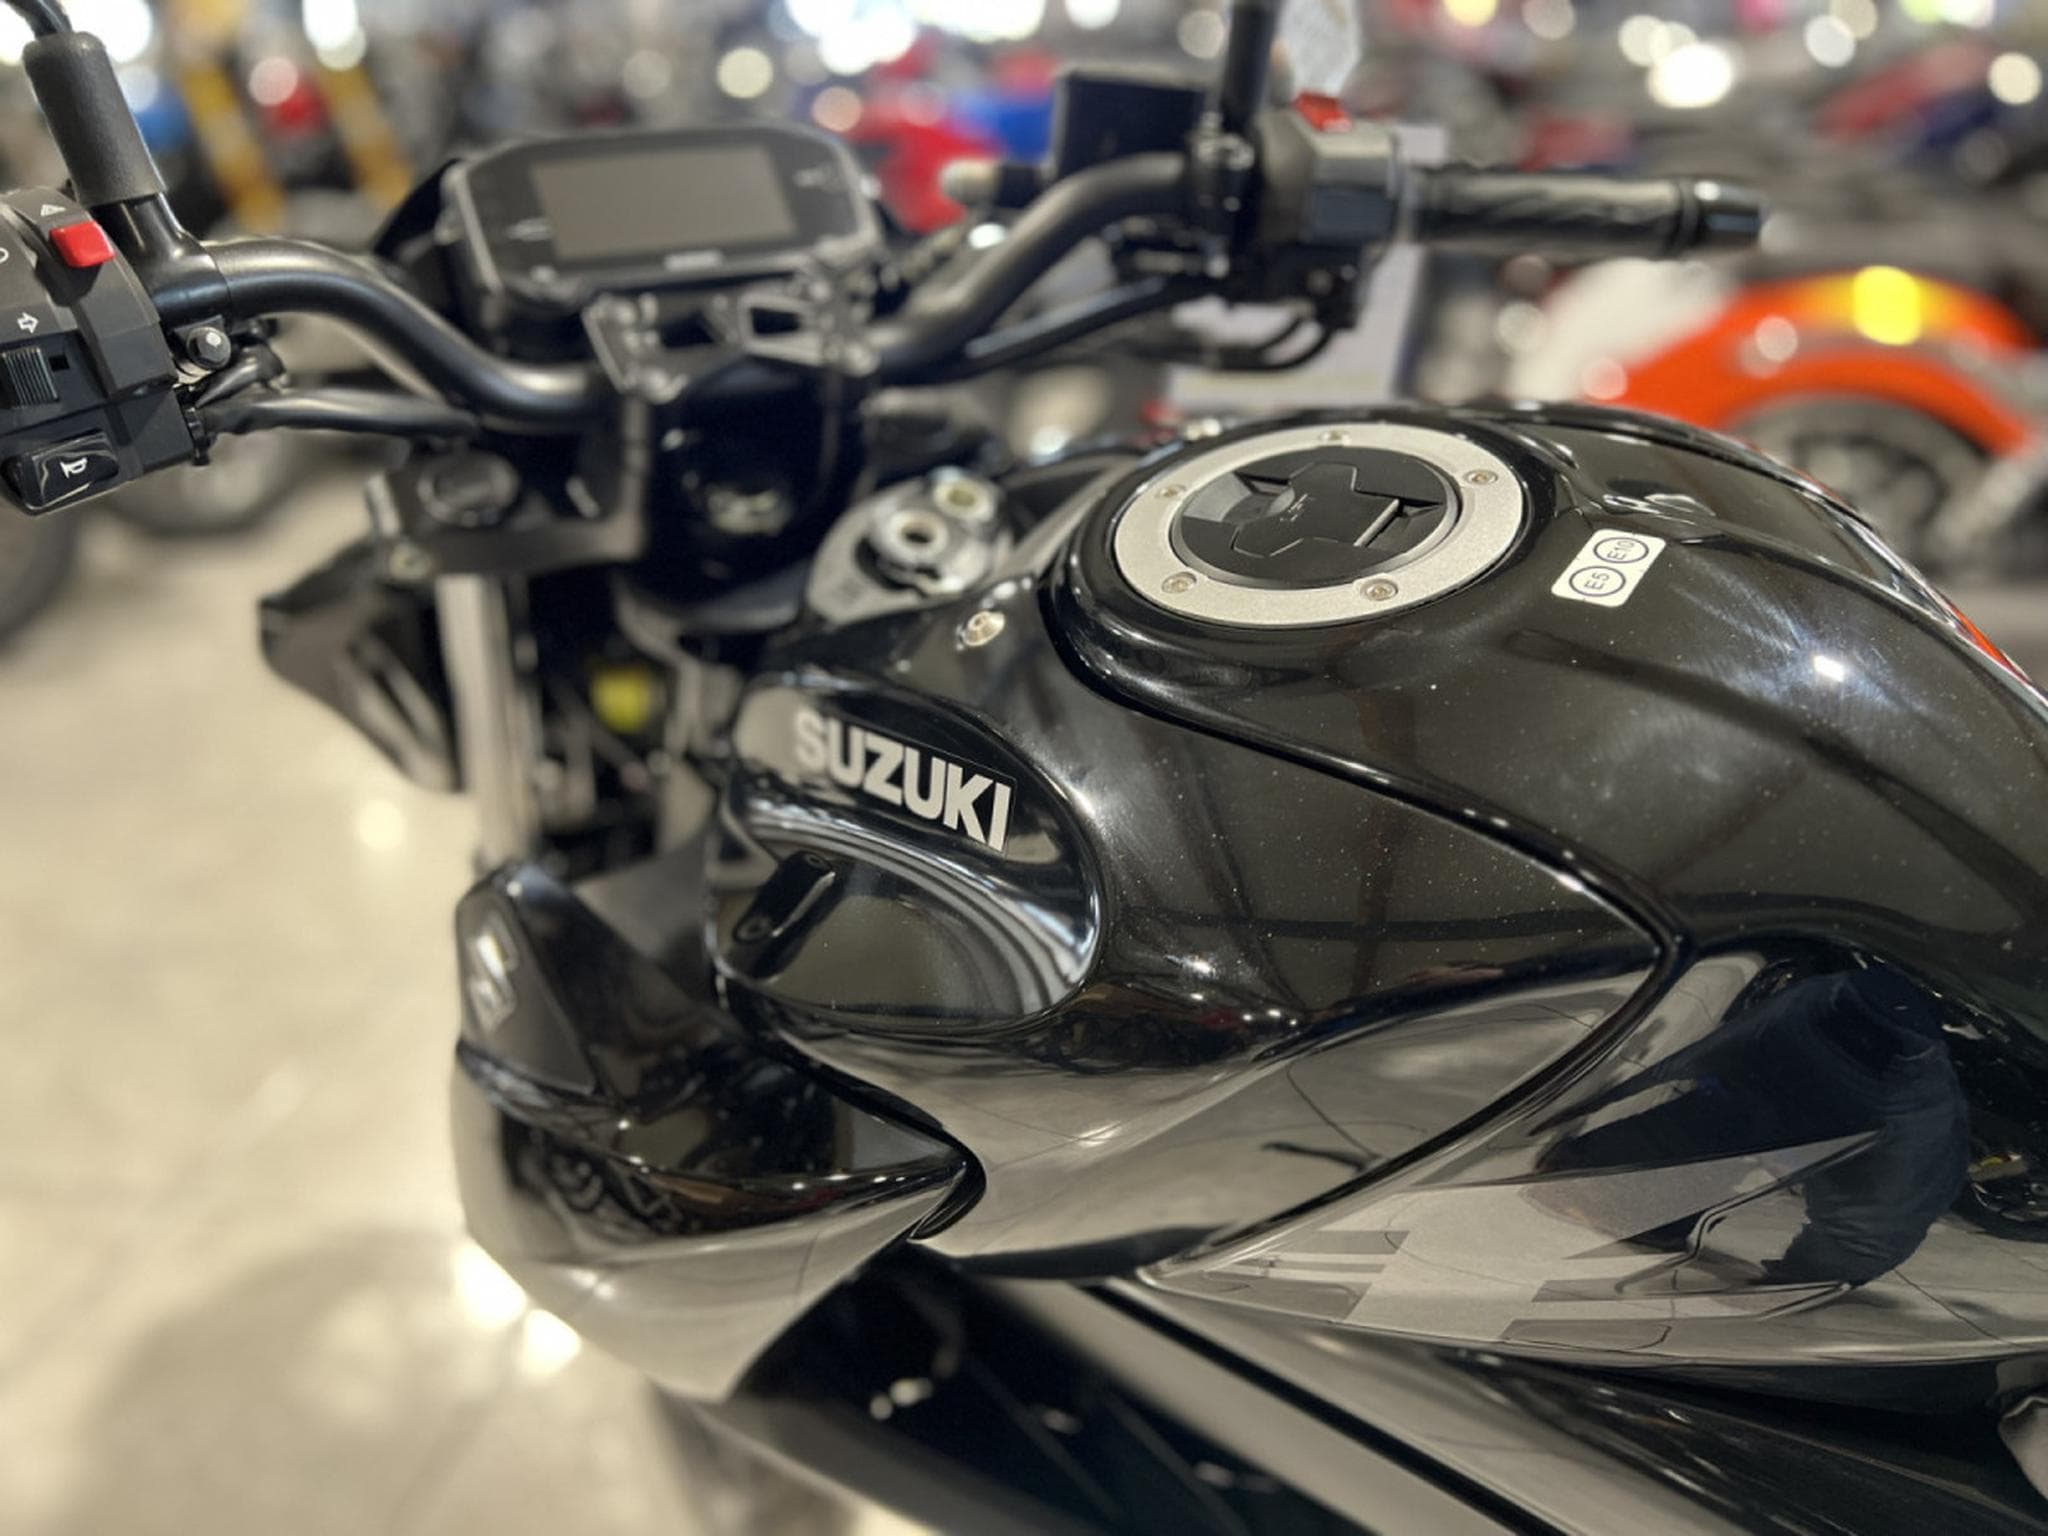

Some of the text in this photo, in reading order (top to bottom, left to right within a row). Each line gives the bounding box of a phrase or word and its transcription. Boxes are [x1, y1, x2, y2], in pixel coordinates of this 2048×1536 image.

[1607, 540, 1635, 561] E10
[1584, 572, 1610, 590] E5
[795, 709, 1011, 852] SUZUKI
